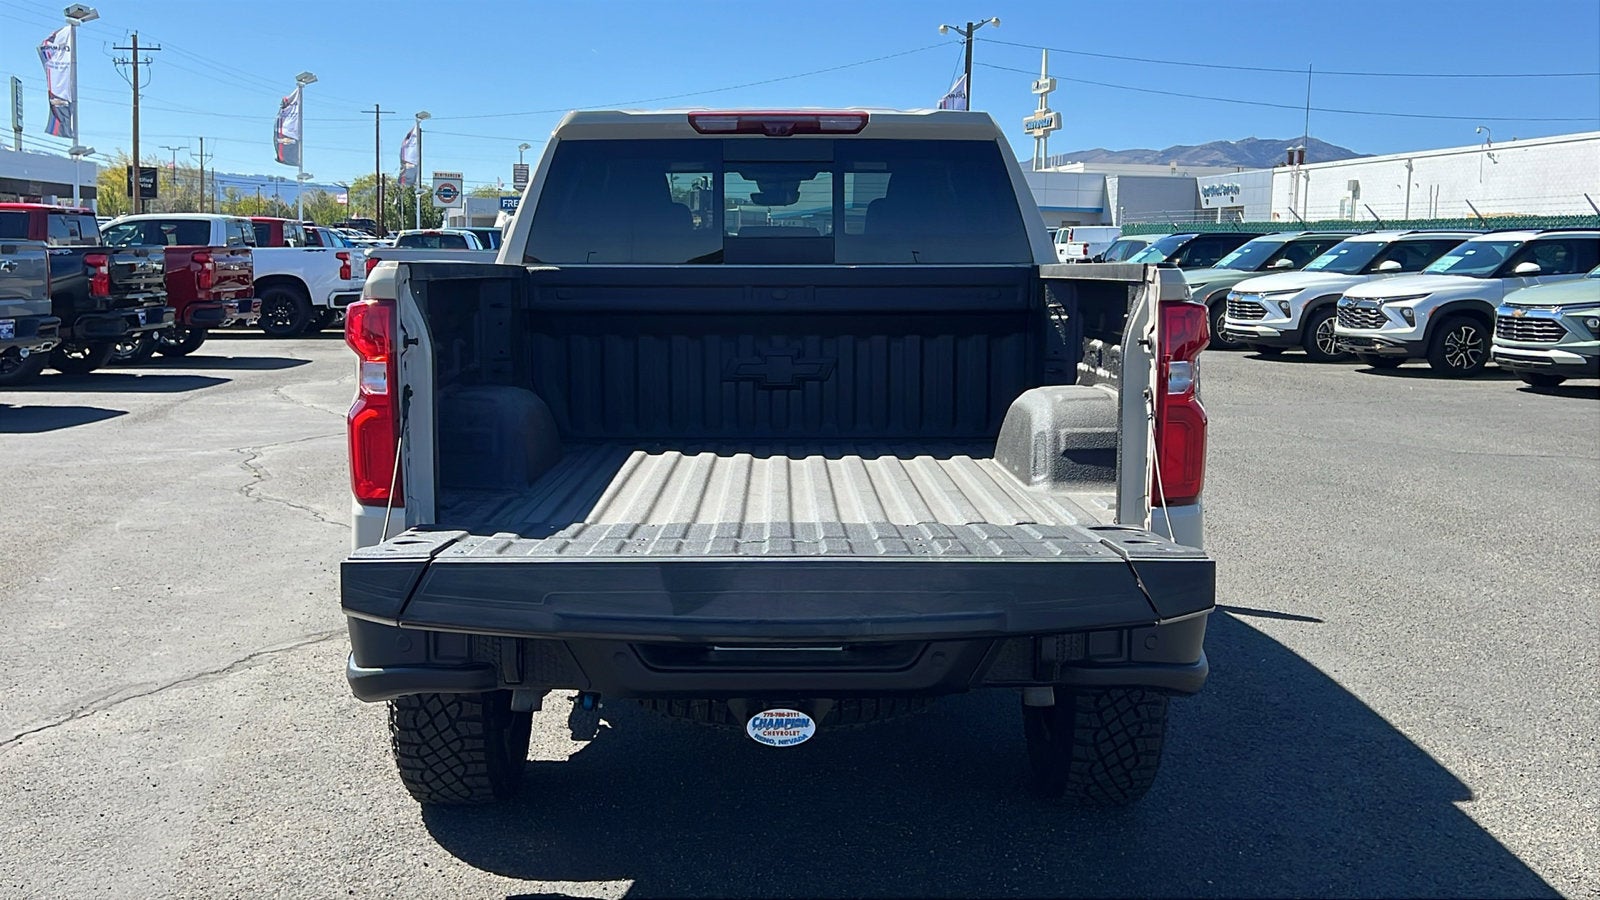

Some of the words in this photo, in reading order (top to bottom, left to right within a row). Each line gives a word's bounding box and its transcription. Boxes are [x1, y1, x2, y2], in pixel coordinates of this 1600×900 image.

[502, 199, 521, 208] FRE
[752, 717, 810, 729] CHAMPION
[778, 734, 808, 745] NEVADA
